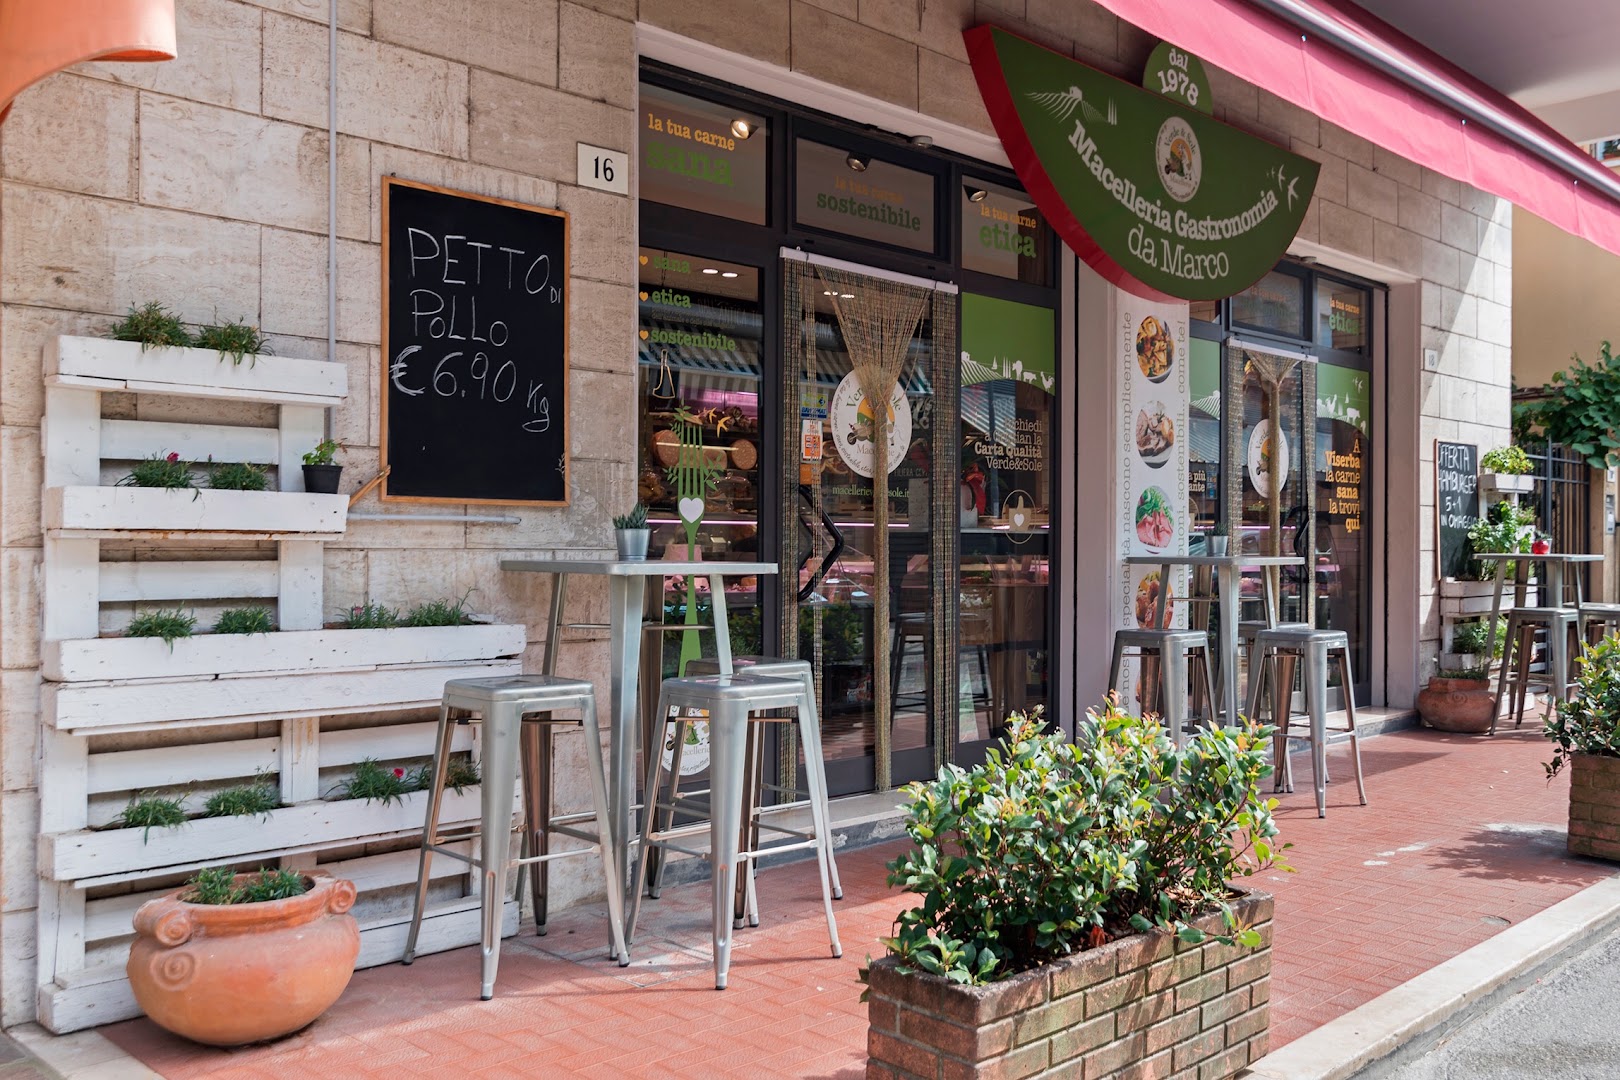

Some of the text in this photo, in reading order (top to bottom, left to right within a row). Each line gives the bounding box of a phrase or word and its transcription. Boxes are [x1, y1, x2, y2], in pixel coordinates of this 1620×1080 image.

[1168, 48, 1188, 72] dal
[1157, 69, 1199, 106] 1978
[648, 112, 735, 151] la tua carne
[594, 156, 614, 182] 16
[646, 141, 735, 187] sana
[1068, 119, 1173, 233] Macelleria
[1174, 189, 1279, 241] Gastronomia
[816, 192, 921, 232] sostenibile
[980, 203, 990, 217] la
[979, 223, 1037, 258] etica
[1128, 223, 1229, 280] da Marco
[407, 227, 551, 295] PETTO
[653, 255, 691, 274] sana
[652, 289, 692, 309] etica
[410, 288, 509, 347] POLLO
[651, 329, 736, 351] sostenibile
[1122, 312, 1133, 453] semplicemente
[974, 441, 1043, 459] Carta Qualità
[984, 432, 992, 442] a
[1033, 433, 1043, 446] la
[1353, 438, 1361, 453] A
[985, 456, 1043, 472] Verde&Sole
[1324, 450, 1361, 469] Viserba
[1193, 469, 1206, 483] più
[1324, 467, 1360, 484] la carne
[1123, 457, 1131, 534] nascono
[1336, 486, 1358, 499] sana
[1328, 498, 1360, 515] la trovi
[1345, 514, 1360, 533] qui
